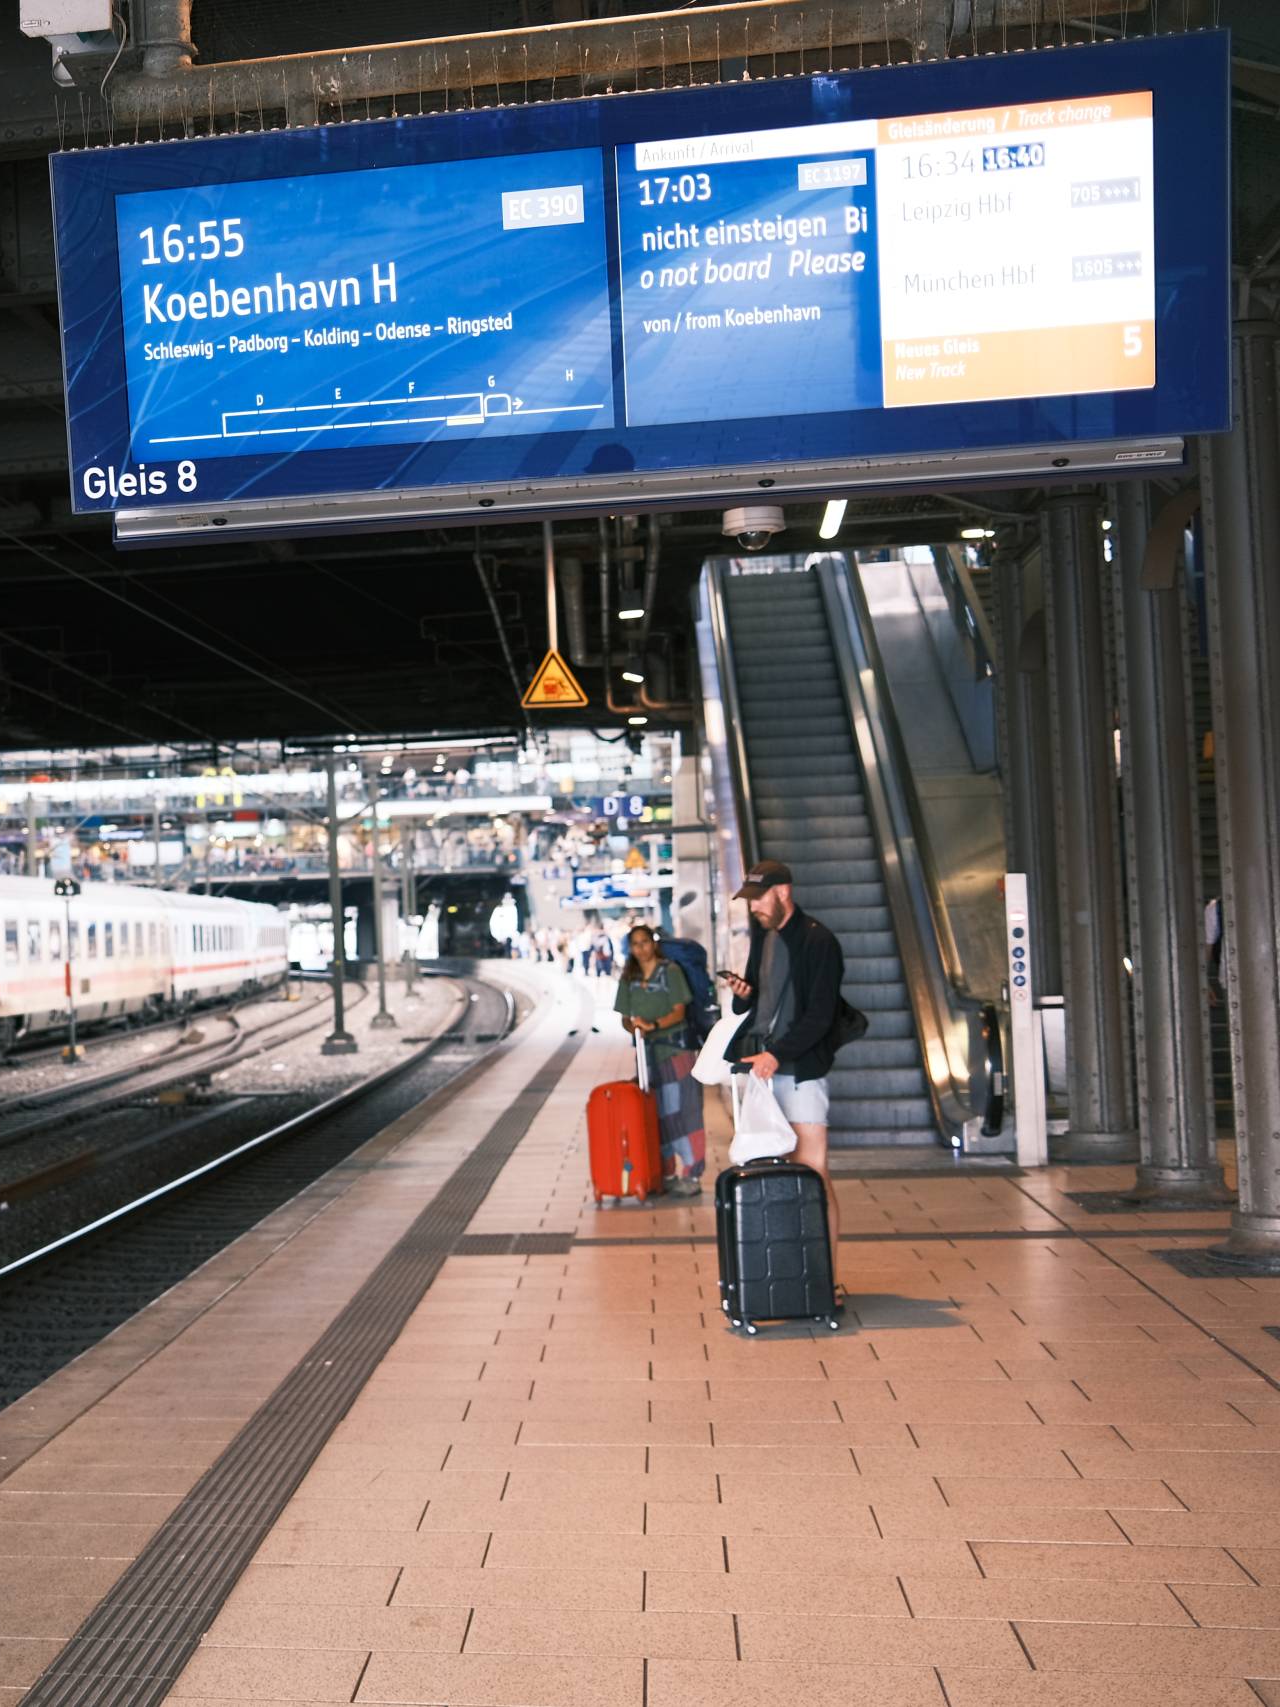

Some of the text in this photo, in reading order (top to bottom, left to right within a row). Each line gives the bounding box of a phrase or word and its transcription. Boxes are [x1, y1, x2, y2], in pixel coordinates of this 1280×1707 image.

[888, 114, 995, 140] Gleisänderung
[1017, 108, 1054, 127] Track
[1058, 103, 1111, 123] change
[642, 144, 695, 164] Ankunft
[709, 139, 754, 157] Arrival
[902, 145, 1044, 180] 16:34 16:40
[638, 173, 711, 206] 17:03
[804, 164, 861, 184] EC 1197
[509, 193, 578, 221] EC 390
[902, 191, 1015, 225] Leipzig Hbf
[1071, 184, 1101, 203] 705
[138, 217, 245, 266] 16:55
[642, 205, 868, 252] nicht einsteigen Bi
[659, 261, 699, 288] not
[704, 252, 772, 285] board
[788, 249, 866, 277] Please
[1001, 263, 1038, 287] Hbf
[1073, 258, 1114, 277] 1605
[142, 261, 397, 325] Koebenhavn H
[643, 303, 821, 334] von / from Koebenhavn
[144, 340, 214, 362] Schleswig
[229, 332, 288, 354] Padborg
[304, 326, 360, 348] Kolding
[375, 321, 431, 342] Odense
[447, 311, 513, 337] Ringsted
[894, 337, 981, 359] Neues Gleis
[1123, 325, 1143, 357] 5
[895, 360, 966, 381] New Track
[256, 368, 574, 406] D E F G H
[83, 460, 198, 500] Gleis 8
[603, 795, 643, 815] D 8
